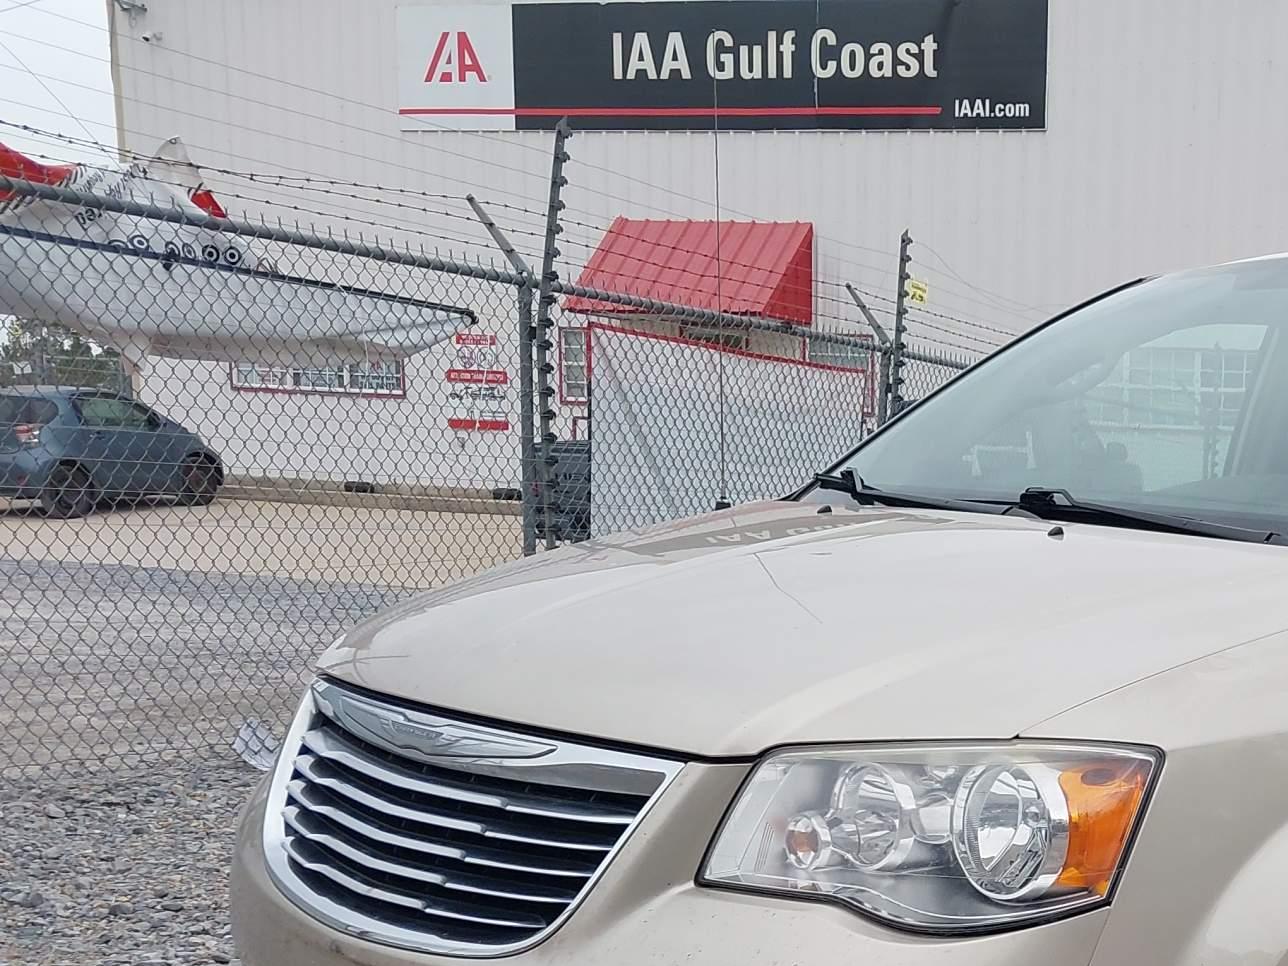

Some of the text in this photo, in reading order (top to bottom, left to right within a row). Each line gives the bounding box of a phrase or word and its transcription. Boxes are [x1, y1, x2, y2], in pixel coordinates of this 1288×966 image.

[612, 28, 938, 80] IAA Gulf Coast
[954, 98, 1030, 118] IAAI.com
